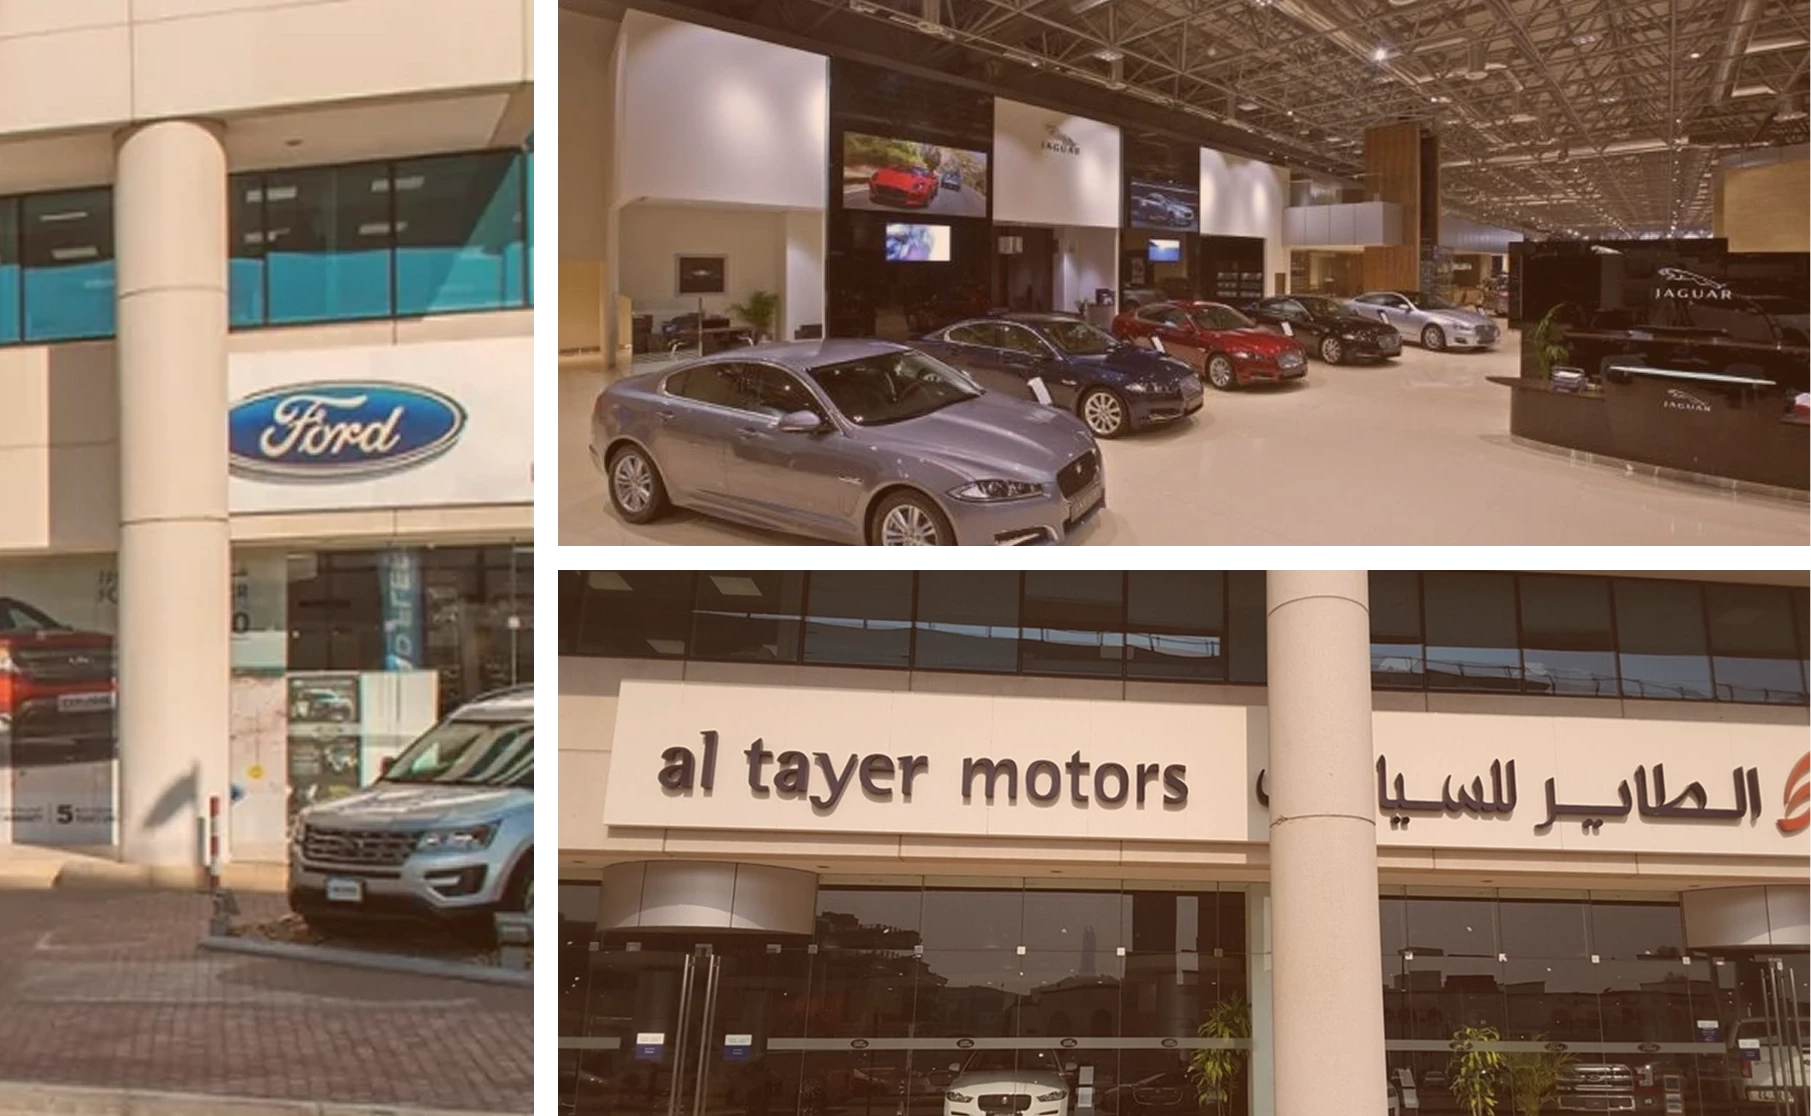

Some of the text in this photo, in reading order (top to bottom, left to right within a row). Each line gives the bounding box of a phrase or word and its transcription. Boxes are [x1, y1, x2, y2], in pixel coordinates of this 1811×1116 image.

[1041, 140, 1080, 155] JAGUAR
[1655, 288, 1732, 299] JAGUAR
[1663, 400, 1711, 412] JAGUAR
[260, 394, 404, 458] Ford
[658, 730, 1189, 811] al tayer motors
